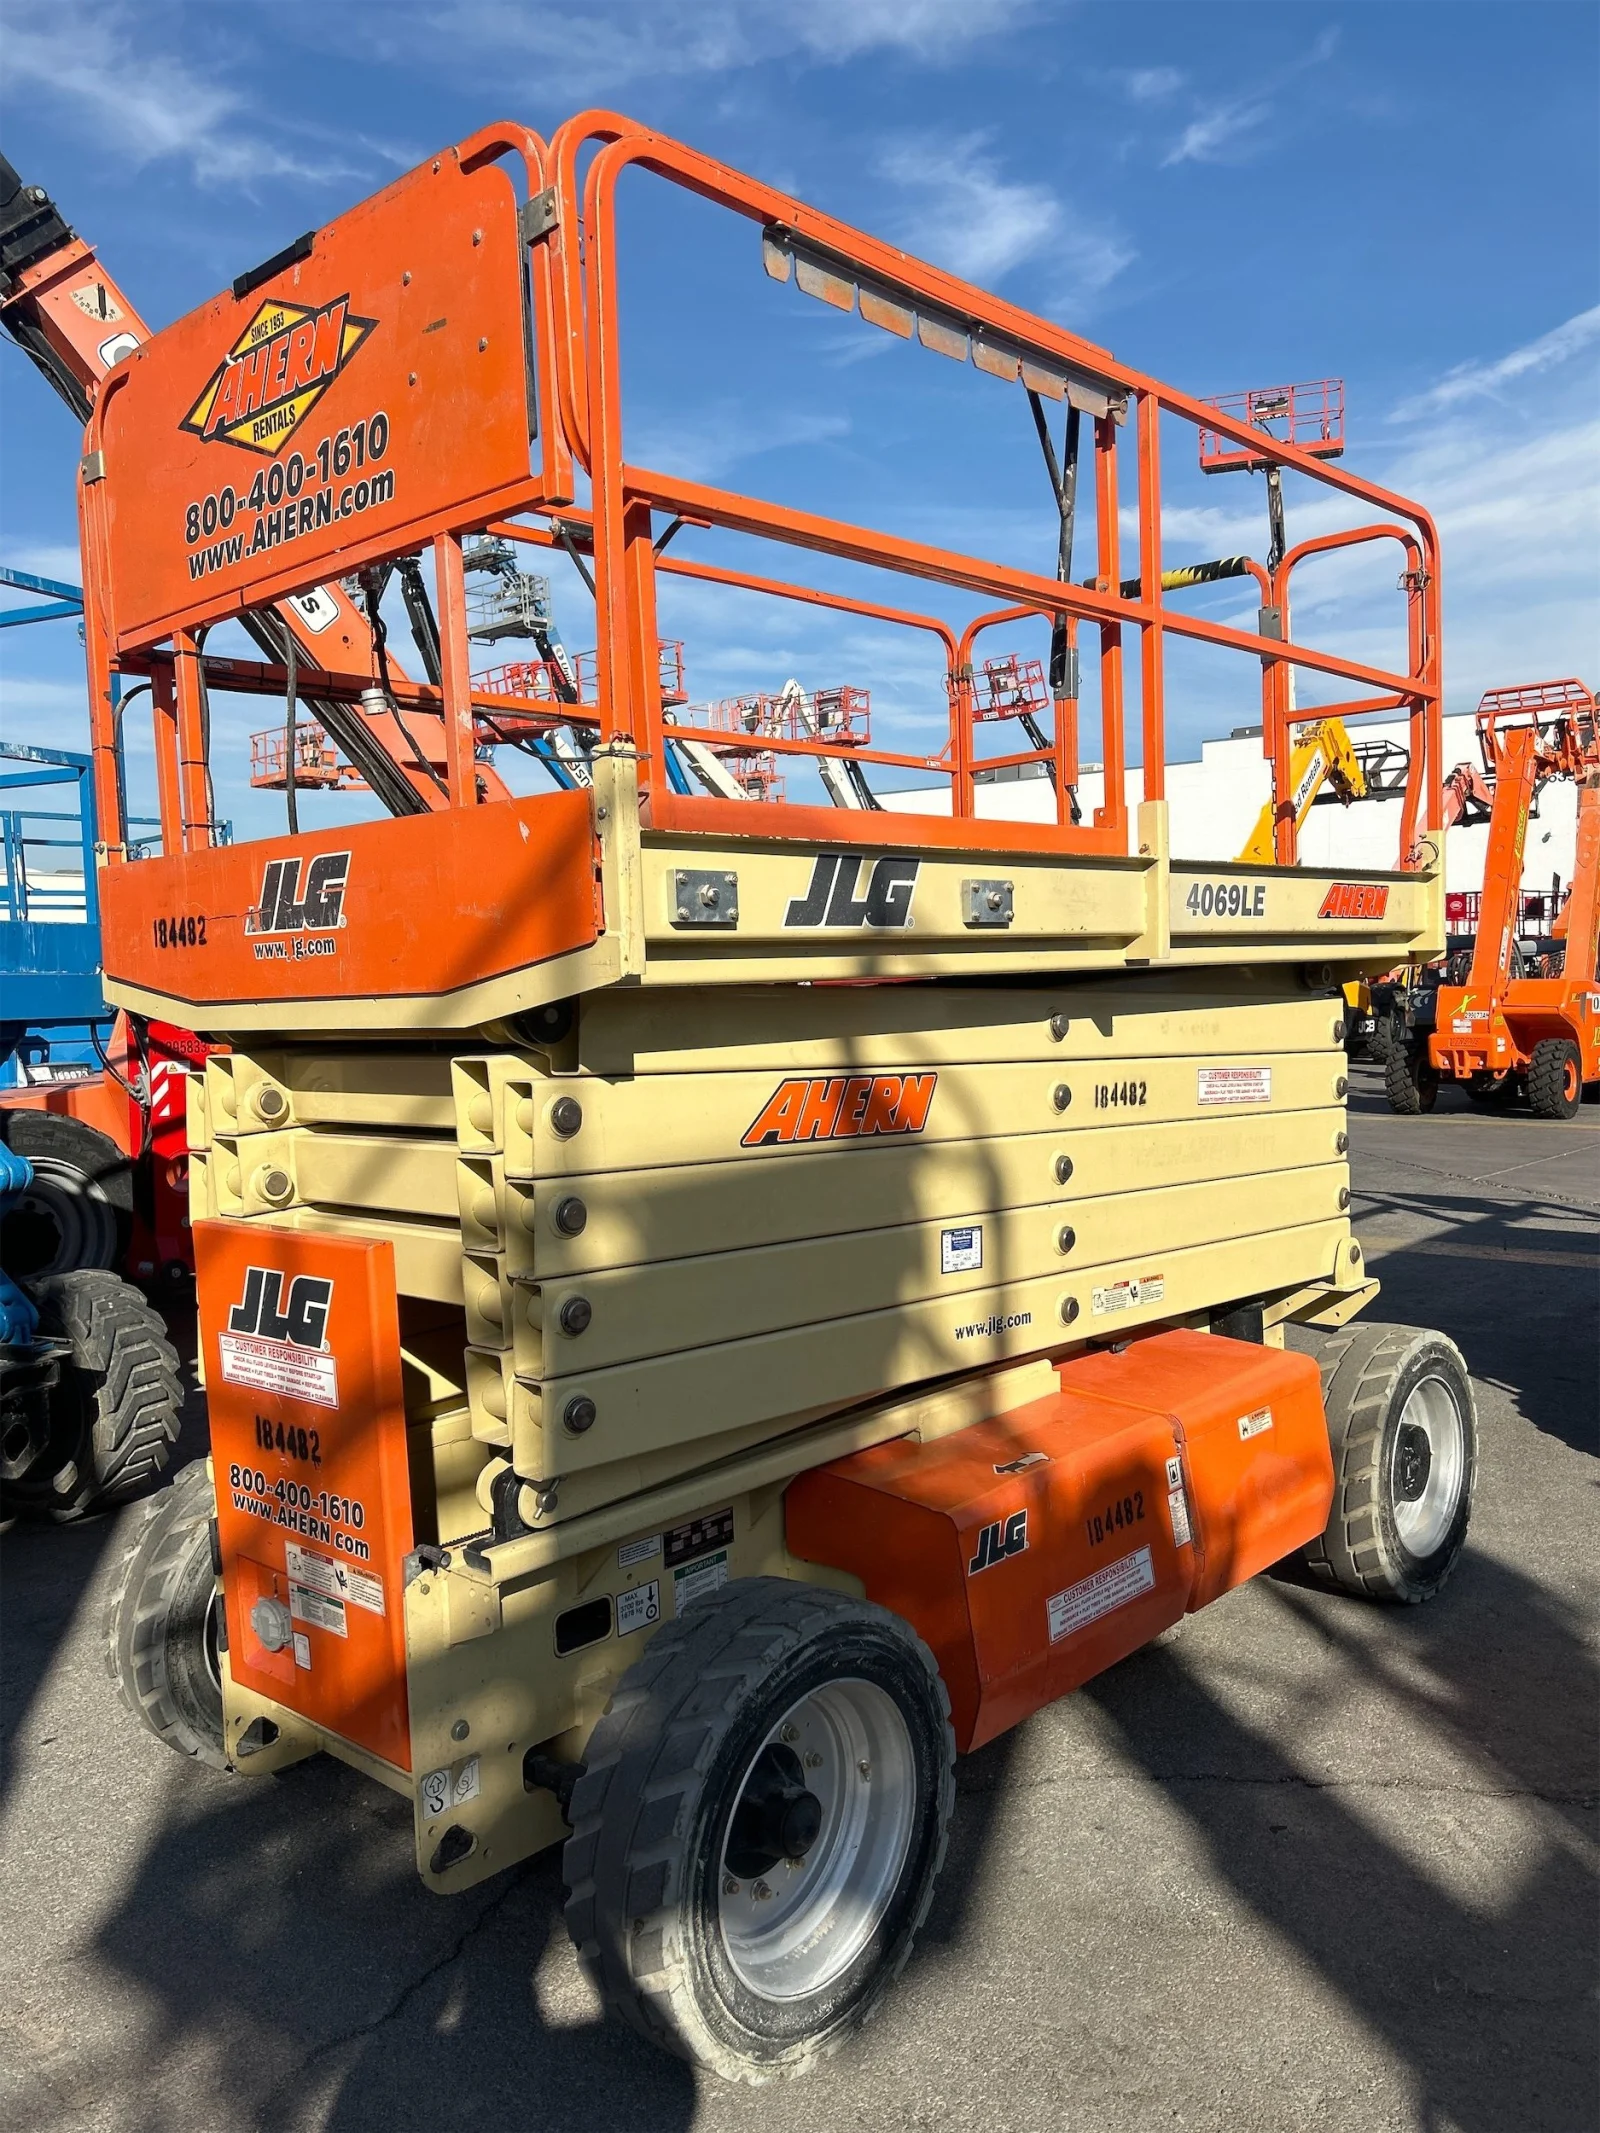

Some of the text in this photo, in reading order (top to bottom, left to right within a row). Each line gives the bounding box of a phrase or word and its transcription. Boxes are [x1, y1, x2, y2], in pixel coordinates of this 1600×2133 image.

[250, 311, 285, 343] SINCE 1953
[203, 301, 347, 437] AHERN
[252, 404, 296, 443] RENTALS
[185, 412, 390, 543] 800-400-1610
[188, 470, 394, 580] www.AHERN.com
[1301, 757, 1321, 799] Rentals
[246, 851, 351, 934] JLG
[783, 853, 922, 928] JLG
[1186, 883, 1266, 917] 4069LE
[1318, 883, 1389, 919] AHERN
[153, 915, 208, 949] 184482
[254, 936, 336, 960] www.lg.com
[1358, 1019, 1376, 1034] JCB
[742, 1073, 937, 1146] AHERN
[1094, 1080, 1148, 1108] 184482
[228, 1266, 334, 1350] JLG
[954, 1311, 1032, 1340] www.jlg.com
[234, 1340, 318, 1368] CUSTOMER RESPONSIBILITY
[255, 1414, 322, 1468] 184482
[229, 1463, 366, 1529] 800-400-1610
[1087, 1490, 1146, 1547] 184482
[968, 1508, 1028, 1577] JLG
[684, 1556, 718, 1575] IMPORTANT
[1063, 1556, 1137, 1604] CUSTOMER RESPONSIBILITY
[624, 1592, 638, 1602] MAX
